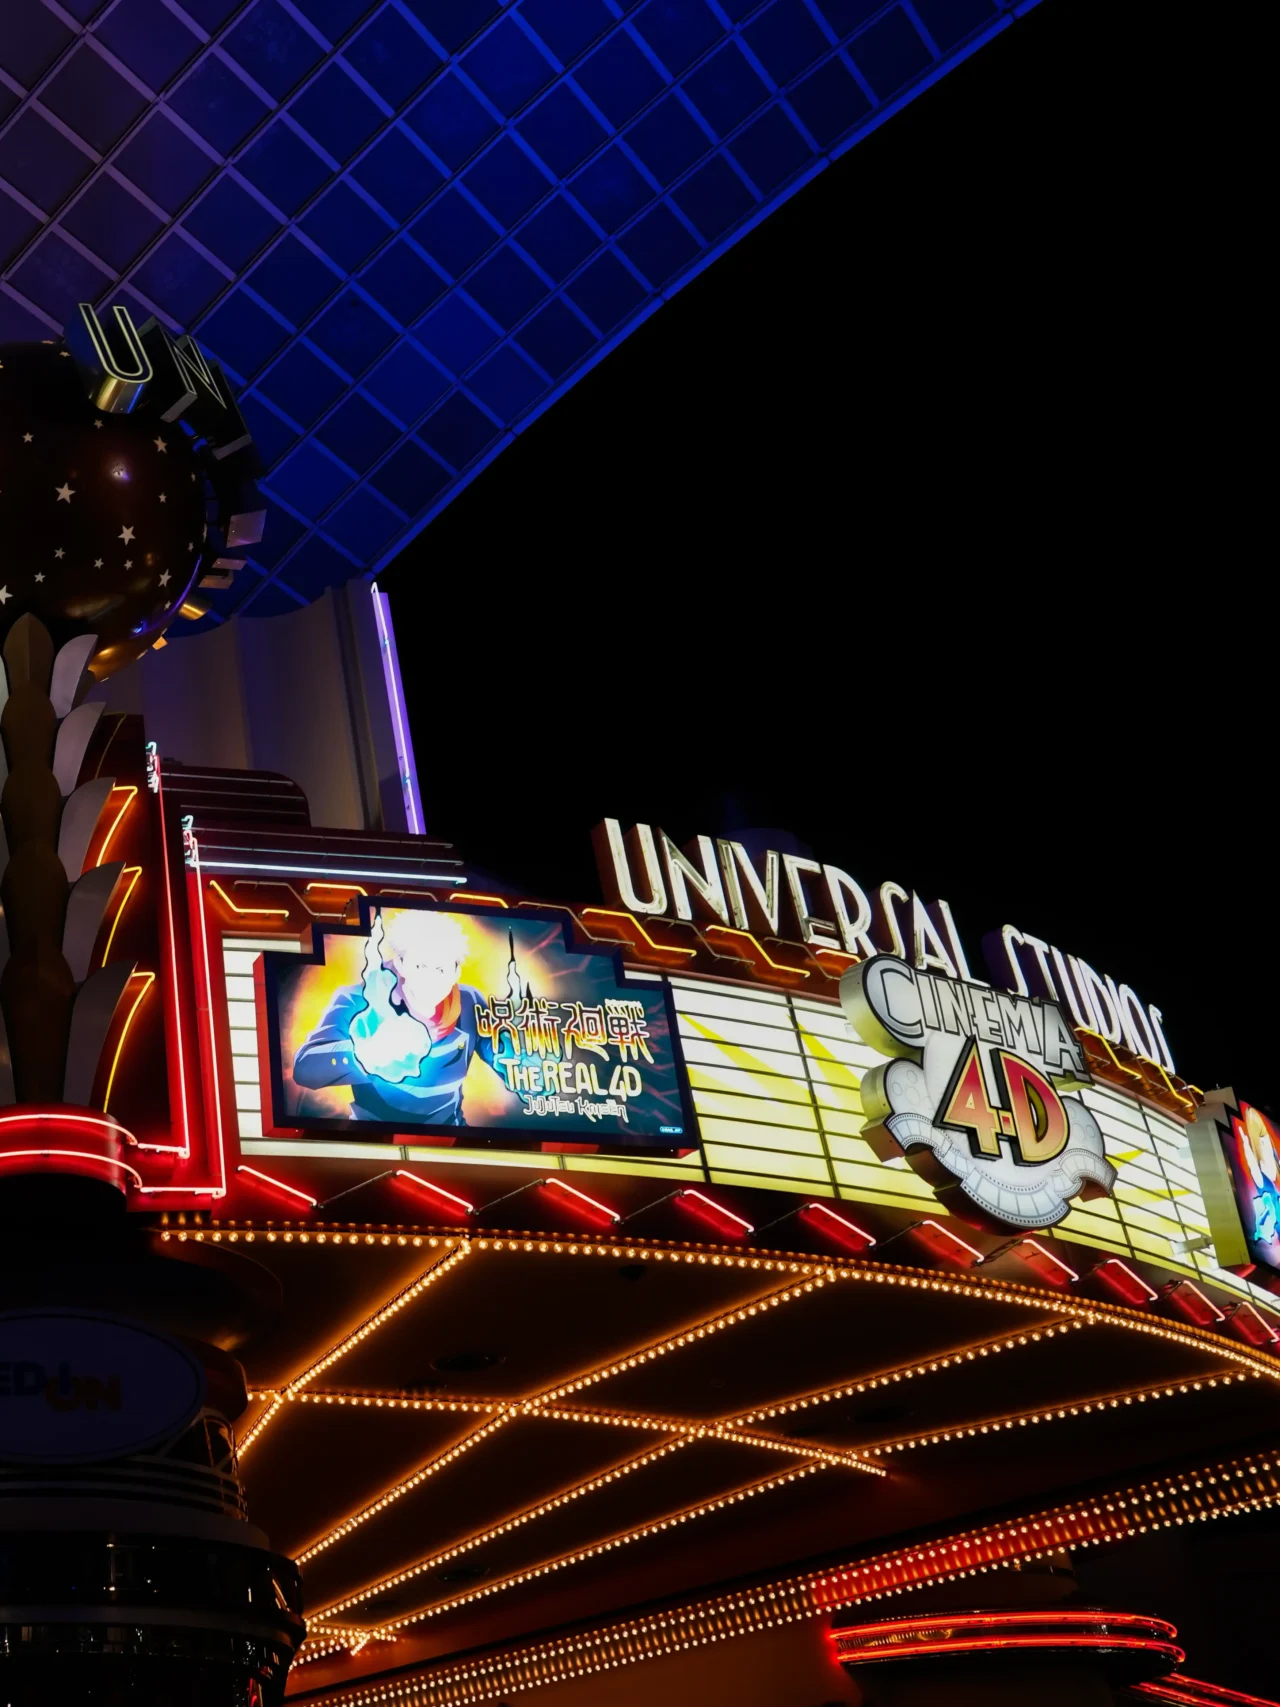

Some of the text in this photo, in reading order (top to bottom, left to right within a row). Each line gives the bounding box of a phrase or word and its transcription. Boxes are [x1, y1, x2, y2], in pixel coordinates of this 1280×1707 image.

[603, 817, 1177, 1076] UNIVERSAL STUDIOS
[474, 995, 655, 1064] 呪術廻戦
[864, 955, 1089, 1076] CINEMA
[498, 1058, 643, 1102] THE REAL 4D
